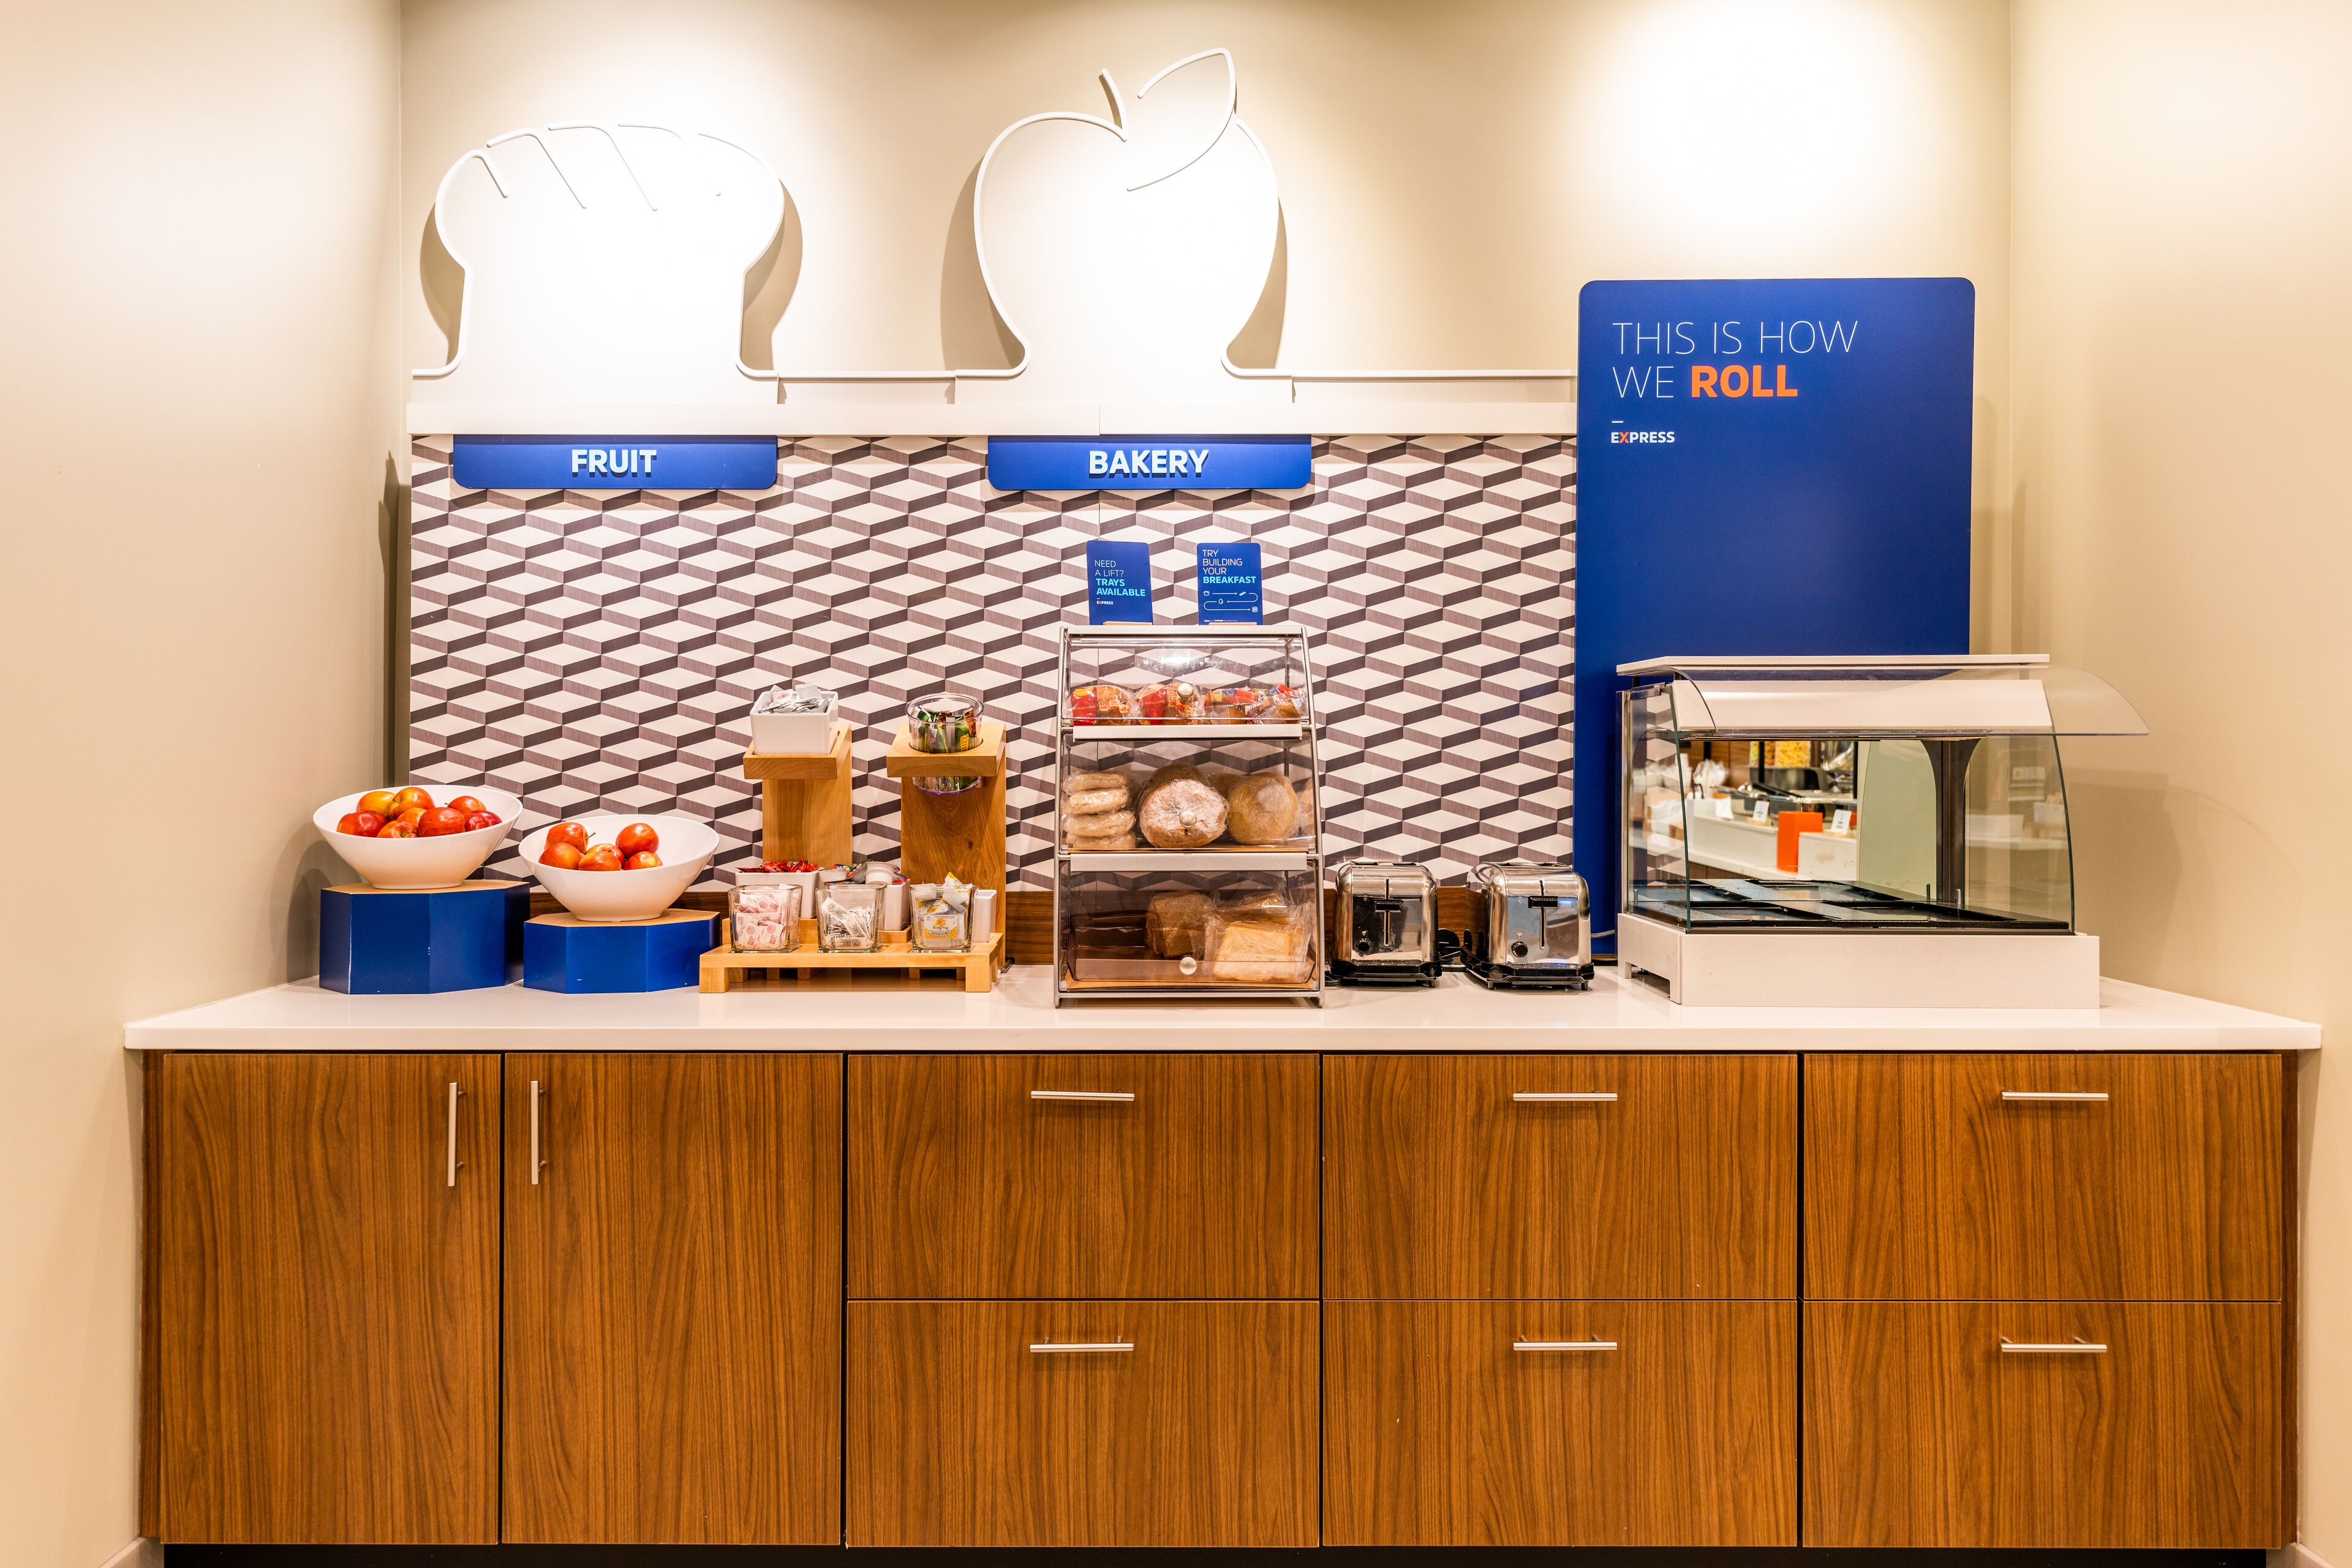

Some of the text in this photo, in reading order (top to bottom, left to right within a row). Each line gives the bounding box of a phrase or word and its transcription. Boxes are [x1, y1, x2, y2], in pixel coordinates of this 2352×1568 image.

[1612, 320, 1858, 355] THIS IS HOW
[1612, 364, 1798, 399] WE ROLL
[1611, 431, 1675, 443] EXPRESS
[571, 449, 657, 473] FRUIT
[1088, 450, 1210, 475] BAKERY
[1094, 559, 1117, 568] NEED
[1202, 558, 1243, 567] BUILDING
[1103, 569, 1125, 578] LIFT?
[1202, 567, 1227, 575] YOUR
[1096, 578, 1125, 587] TRAYS
[1203, 576, 1257, 584] BREAKFAST
[1096, 587, 1146, 597] AVAILABLE
